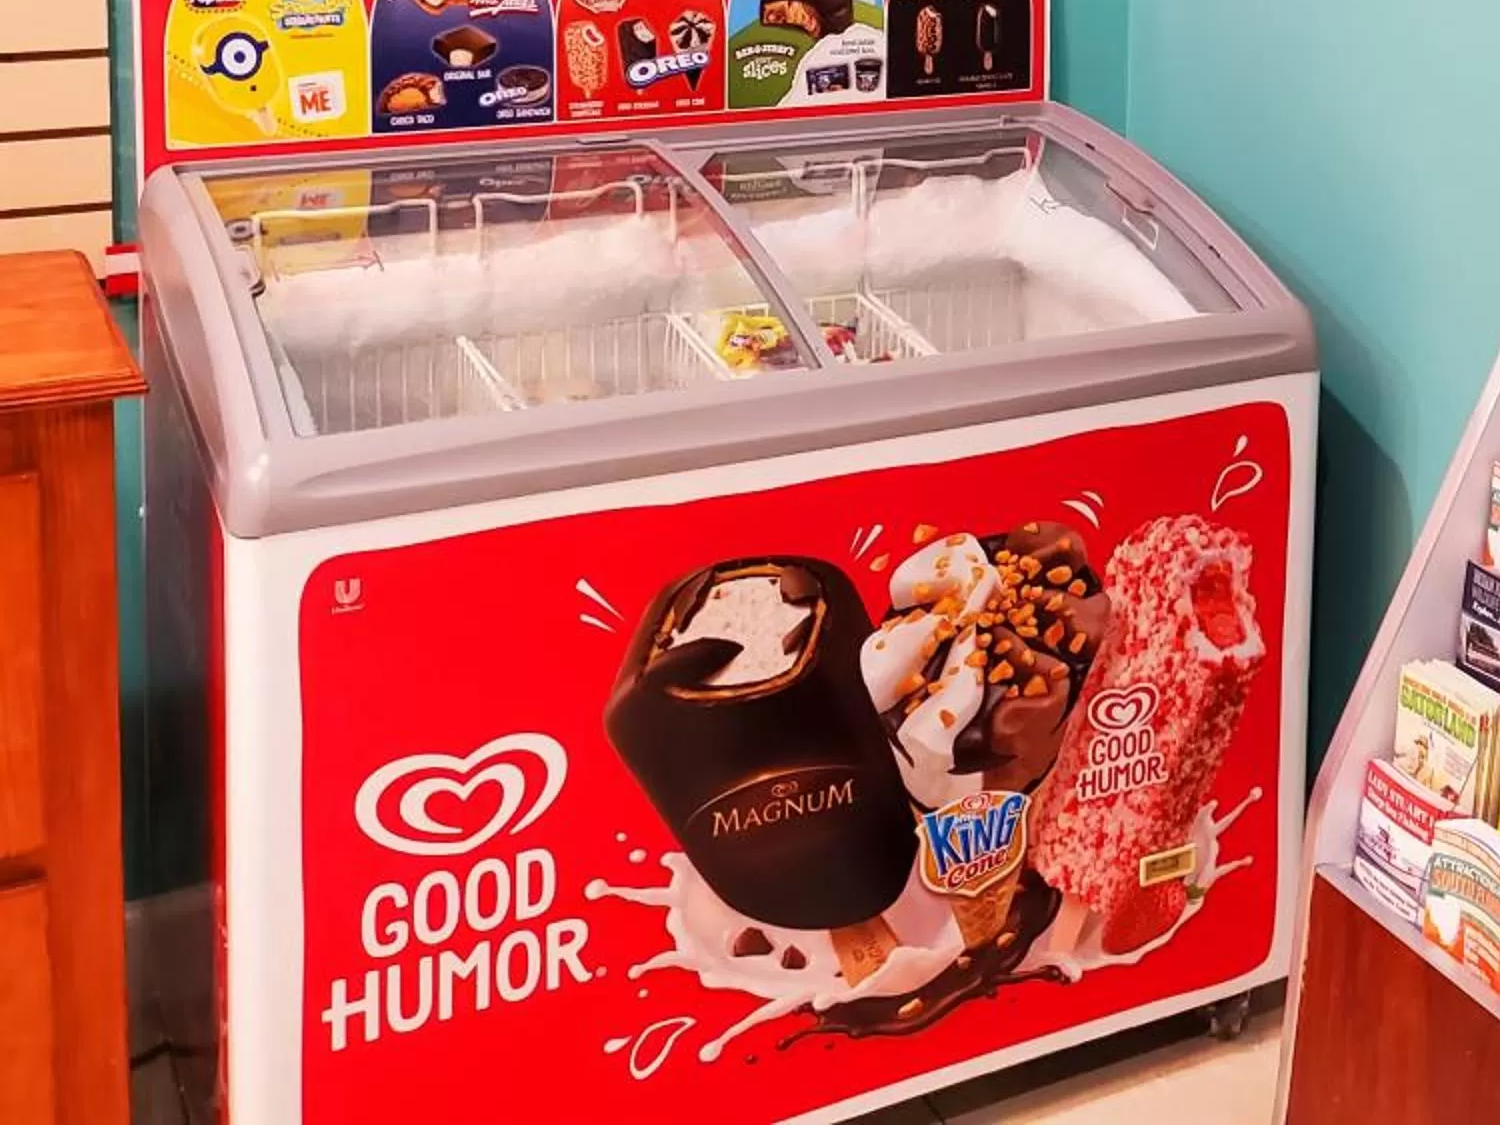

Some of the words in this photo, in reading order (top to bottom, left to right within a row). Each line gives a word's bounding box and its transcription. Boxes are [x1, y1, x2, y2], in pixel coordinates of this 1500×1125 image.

[629, 52, 709, 83] OREO
[299, 89, 332, 115] ME
[1090, 724, 1153, 768] GOOD
[1076, 750, 1166, 800] HUMOR
[711, 777, 857, 838] MAGNUM
[922, 794, 1028, 875] KING
[946, 845, 1012, 890] Cone
[360, 847, 557, 959] GOOD
[320, 917, 594, 1052] HUMOR
